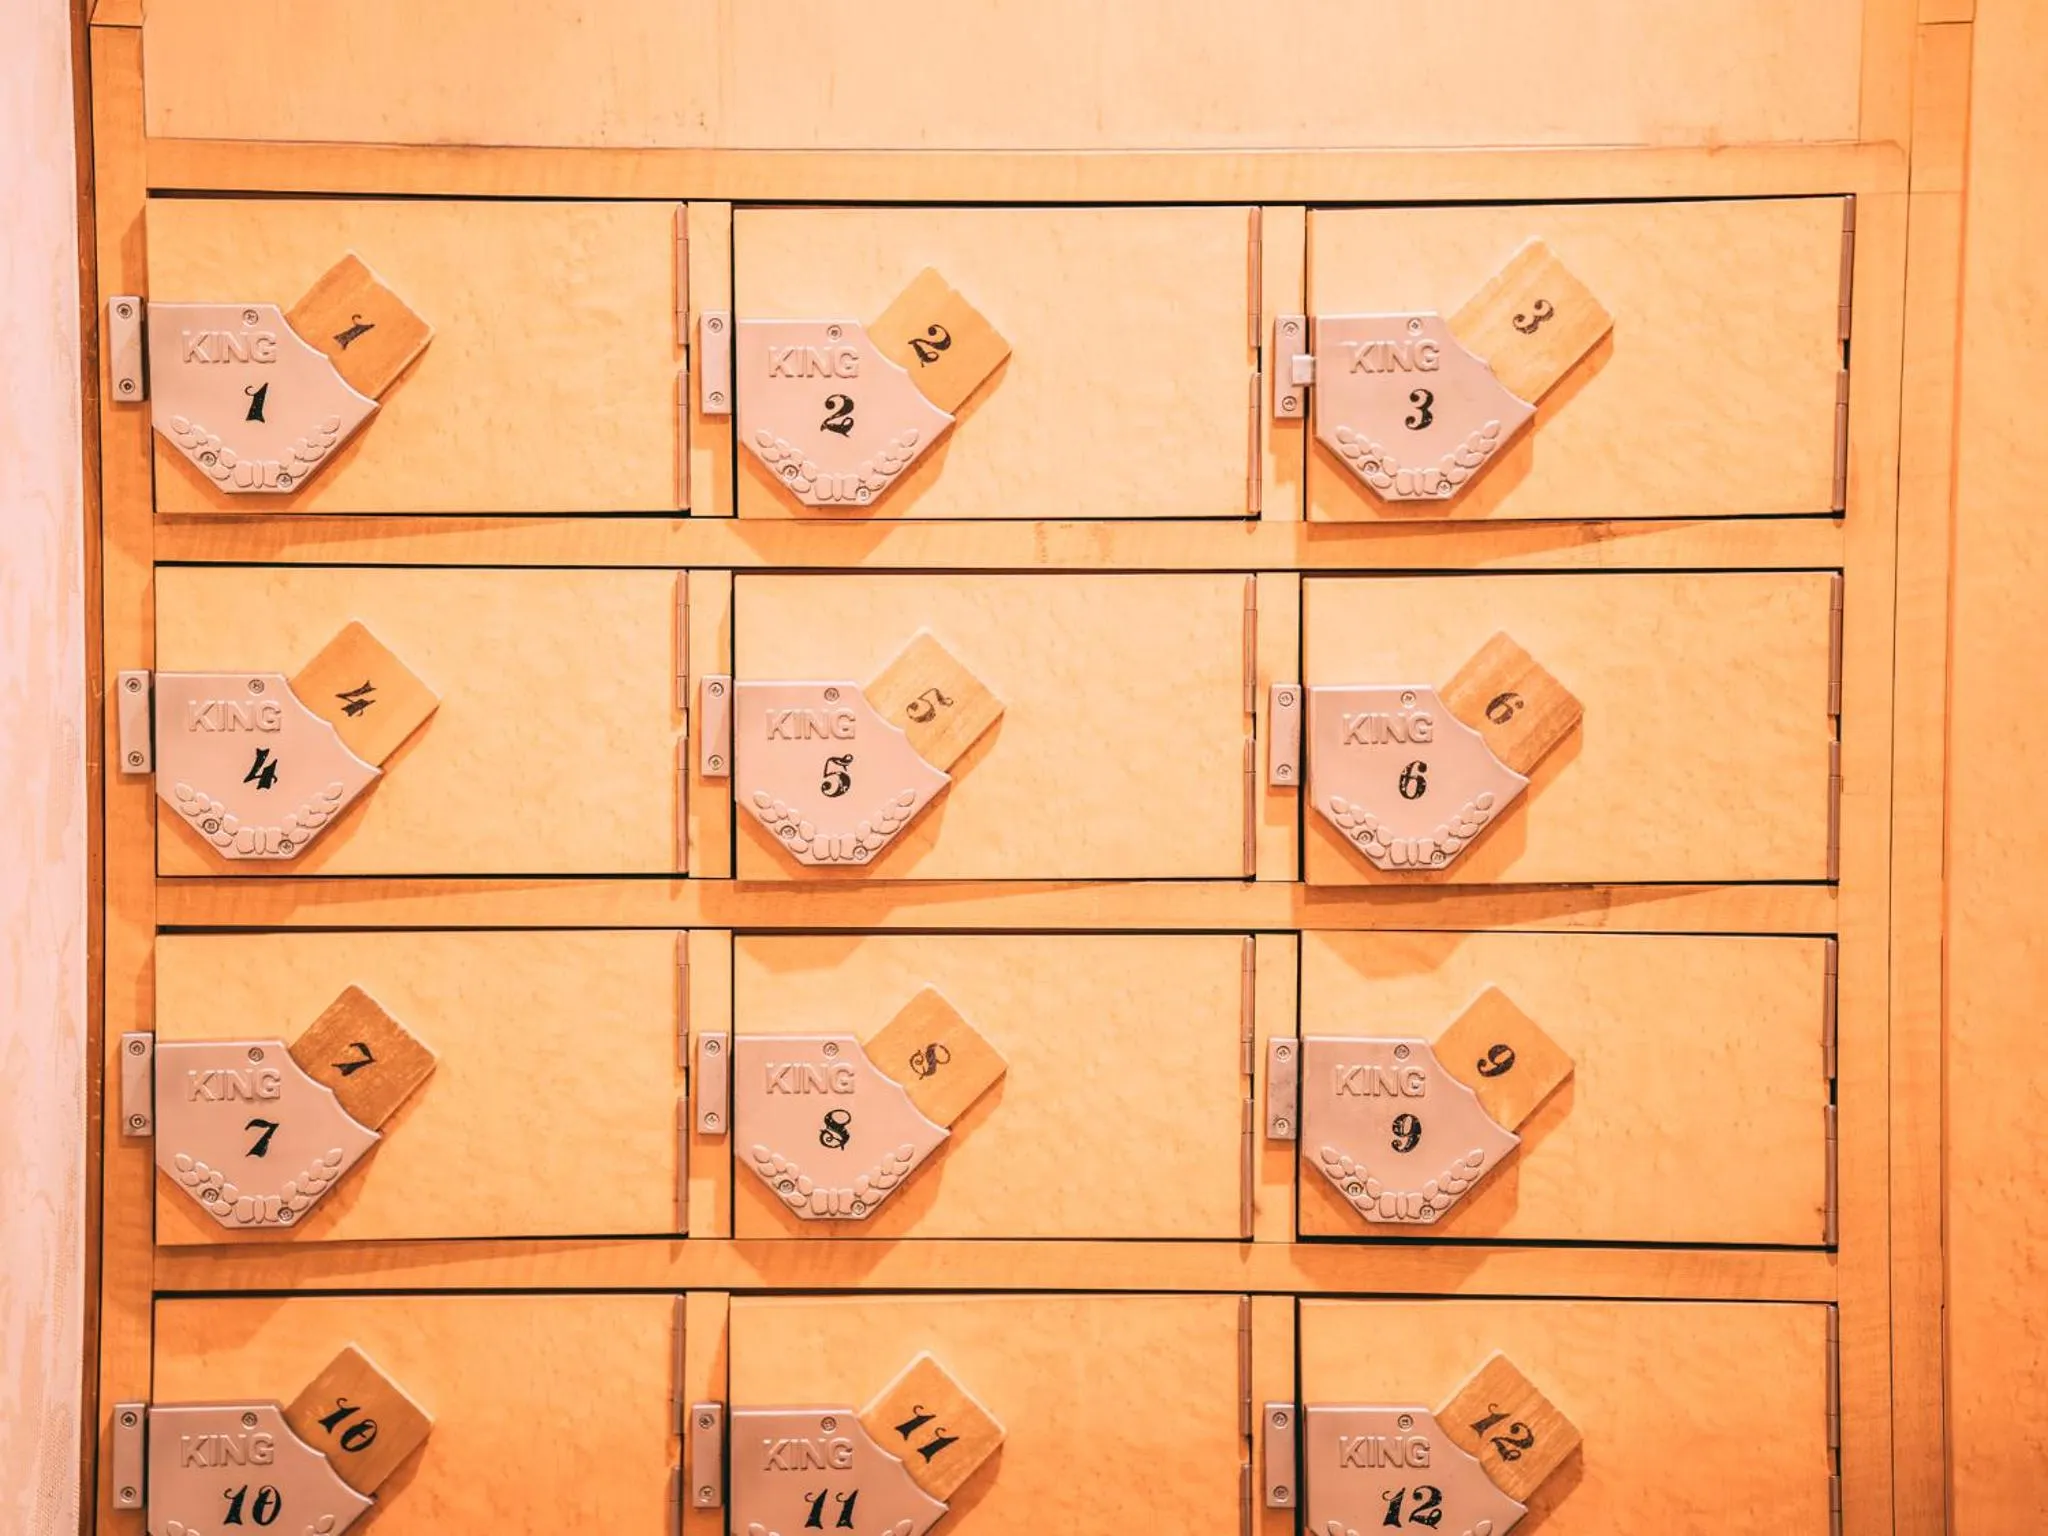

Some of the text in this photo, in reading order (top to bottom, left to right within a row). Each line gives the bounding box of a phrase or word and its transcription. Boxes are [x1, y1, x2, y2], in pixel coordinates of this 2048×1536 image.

[333, 314, 376, 351] 1
[1512, 299, 1554, 335] 3
[183, 329, 278, 365] KING
[768, 345, 858, 379] KING
[907, 323, 952, 369] 2
[1347, 339, 1439, 374] KING
[244, 382, 269, 424] 1
[819, 393, 855, 438] 2
[1404, 388, 1435, 431] 3
[188, 697, 283, 733] KING
[335, 679, 377, 718] 4
[906, 687, 954, 724] 5
[1485, 692, 1524, 725] 6
[767, 707, 856, 741] KING
[1342, 711, 1433, 745] KING
[242, 747, 279, 791] 4
[820, 753, 854, 799] 5
[1398, 760, 1428, 801] 6
[331, 1042, 377, 1077] 7
[764, 1061, 854, 1095] KING
[909, 1042, 951, 1081] 8
[1476, 1043, 1516, 1078] 9
[187, 1068, 282, 1103] KING
[1334, 1063, 1425, 1098] KING
[244, 1118, 280, 1159] 7
[818, 1108, 852, 1151] 8
[1390, 1113, 1423, 1154] 9
[317, 1397, 377, 1451] 10
[894, 1405, 960, 1465] 11
[1470, 1402, 1535, 1463] 12
[180, 1431, 275, 1468] KING
[764, 1435, 853, 1471] KING
[1340, 1433, 1431, 1469] KING
[223, 1484, 282, 1527] 10
[804, 1488, 859, 1530] 11
[1381, 1485, 1443, 1530] 12
